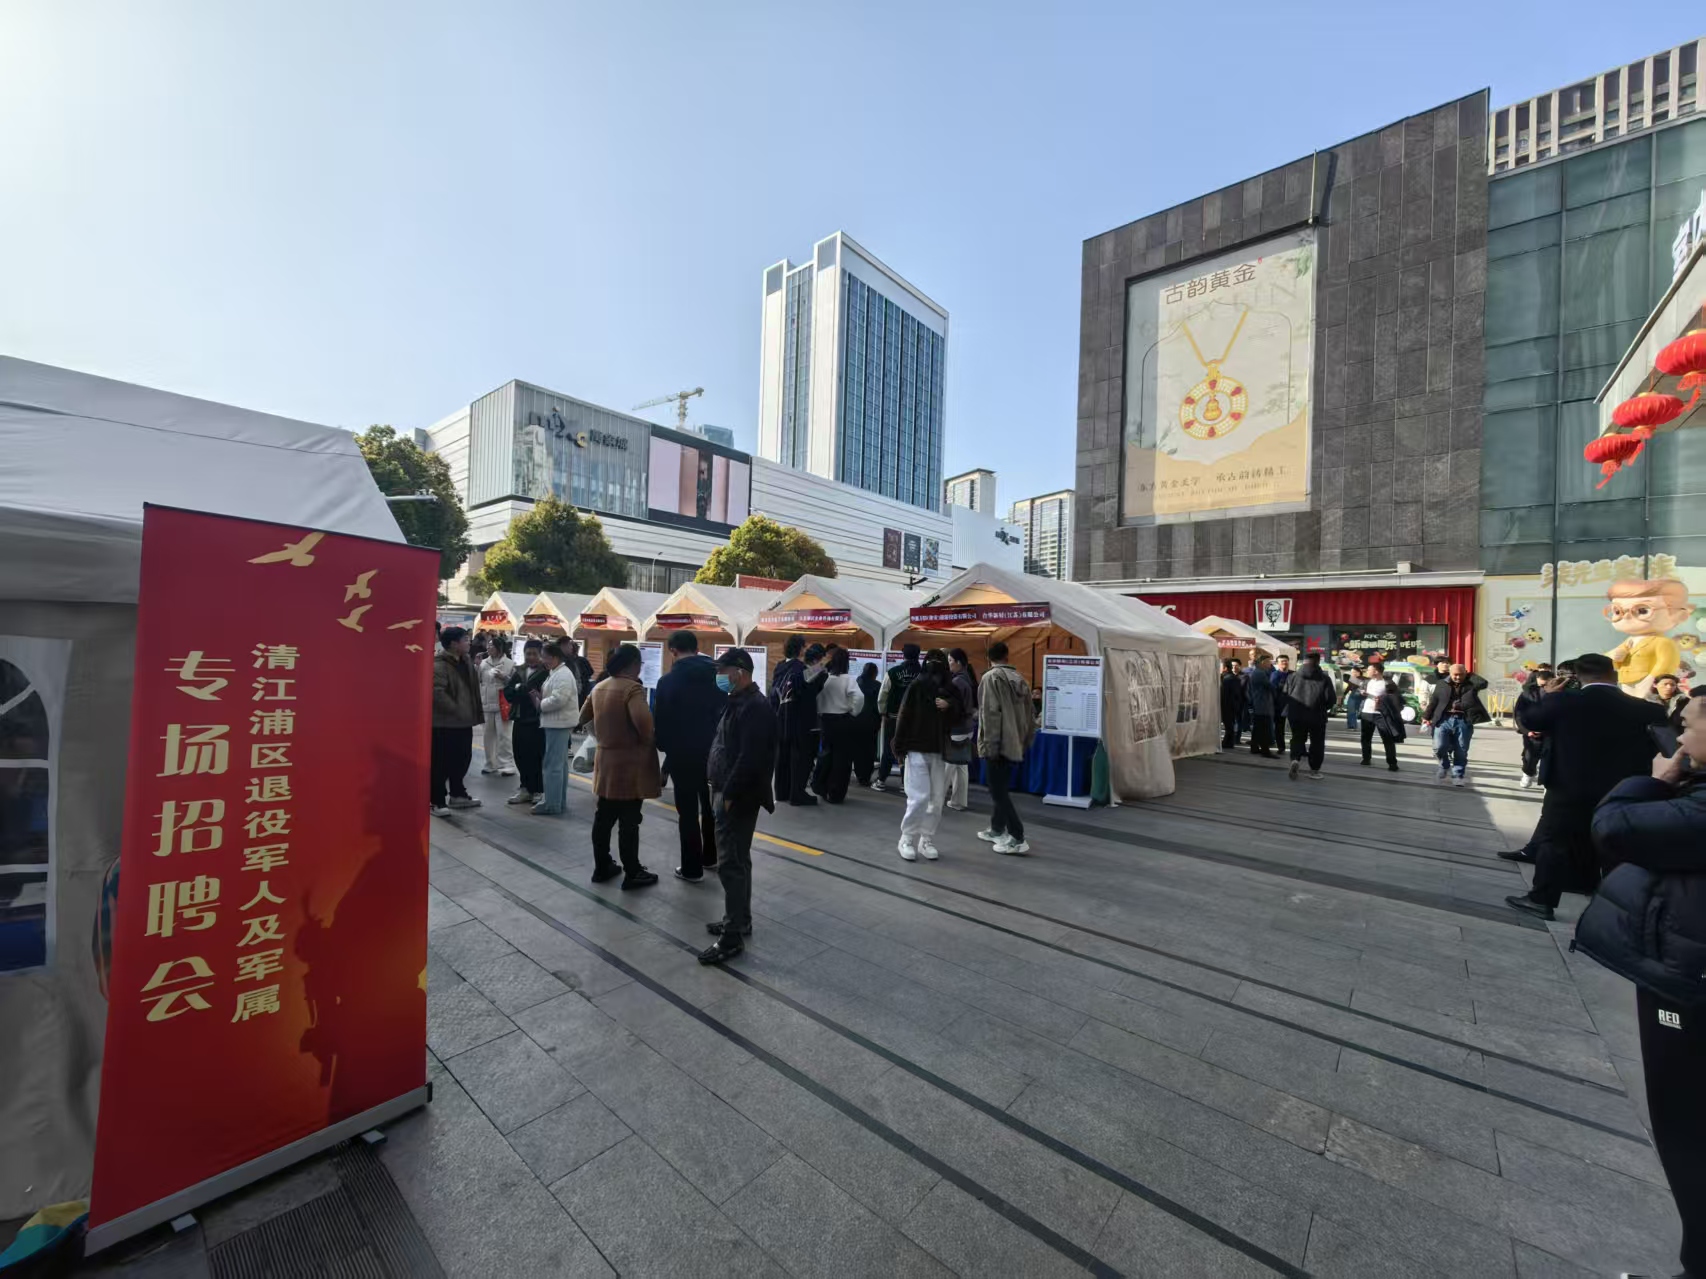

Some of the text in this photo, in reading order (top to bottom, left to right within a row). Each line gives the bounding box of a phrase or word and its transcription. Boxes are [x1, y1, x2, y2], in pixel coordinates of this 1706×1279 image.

[1165, 262, 1257, 305] 古韵黄金
[140, 649, 236, 1023] 专场招聘会
[230, 642, 300, 1024] 清江浦区退役军人及军属
